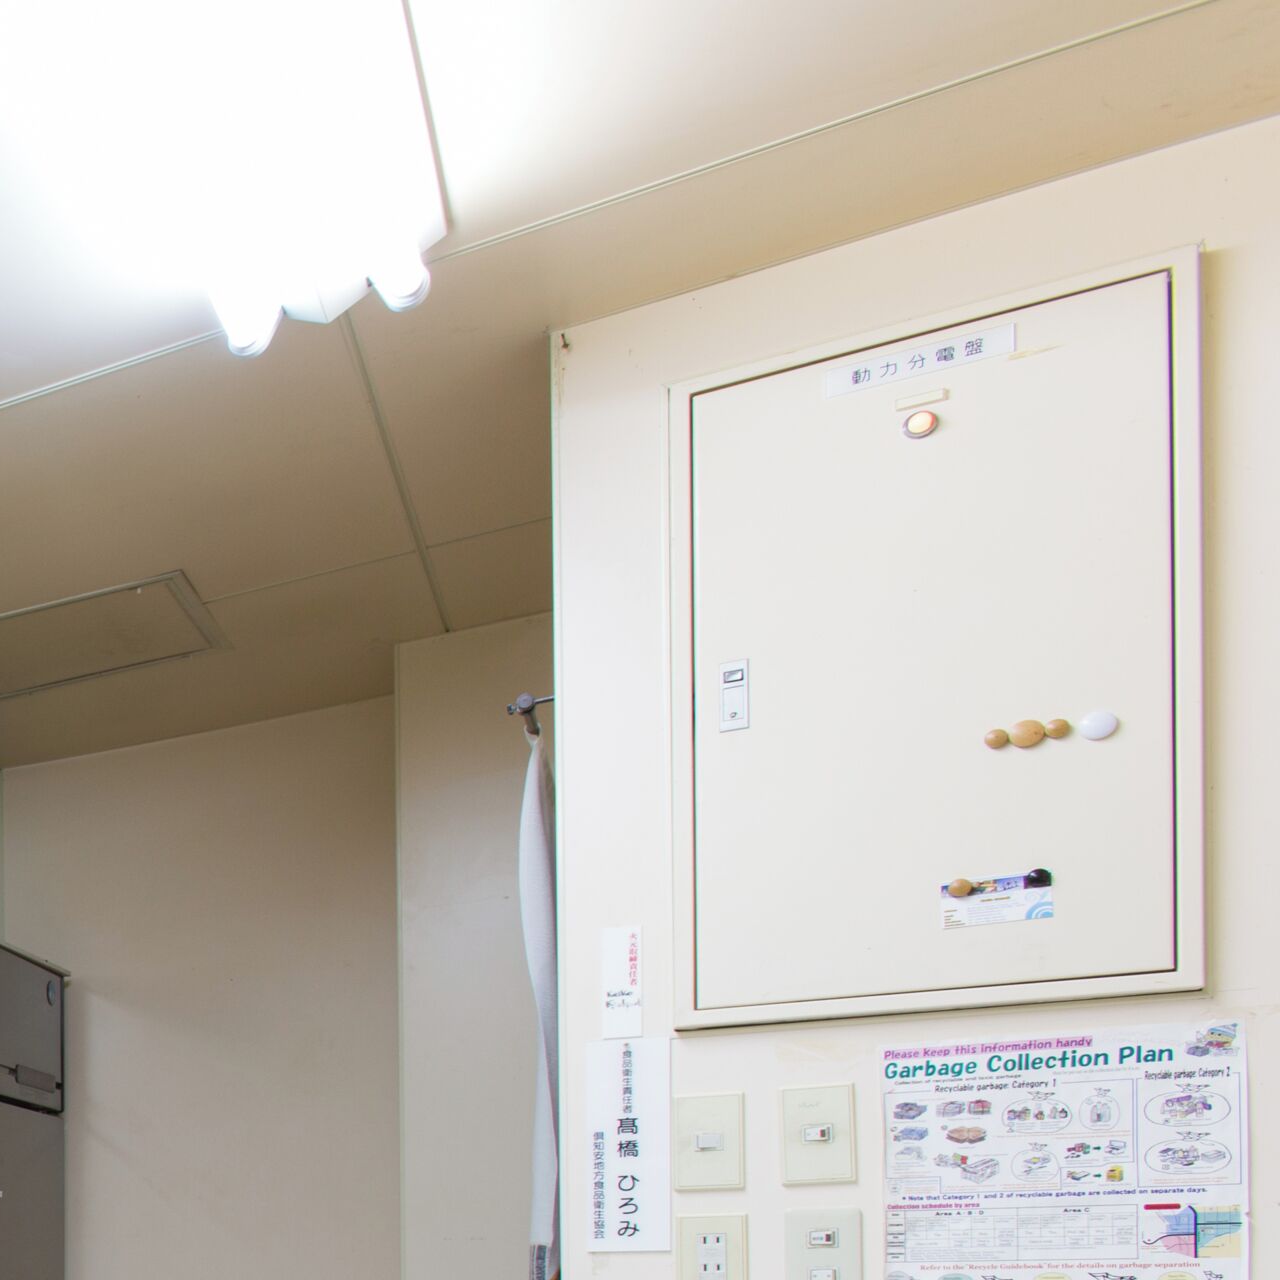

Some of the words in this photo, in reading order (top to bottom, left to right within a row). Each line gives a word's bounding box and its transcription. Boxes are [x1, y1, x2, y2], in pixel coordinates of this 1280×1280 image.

[851, 338, 984, 385] 動力分電盤
[884, 1049, 919, 1060] Please
[955, 1045, 977, 1056] this
[980, 1040, 1052, 1053] information
[1056, 1037, 1093, 1050] handy
[885, 1059, 978, 1079] Garbage
[987, 1050, 1109, 1073] Collection
[1119, 1045, 1174, 1064] Plan
[1198, 1068, 1224, 1078] Category
[935, 1084, 974, 1093] Recyclable
[1012, 1080, 1049, 1090] Category
[617, 1175, 640, 1237] ひろみ
[1118, 1262, 1152, 1270] garbage
[1154, 1261, 1200, 1270] separation
